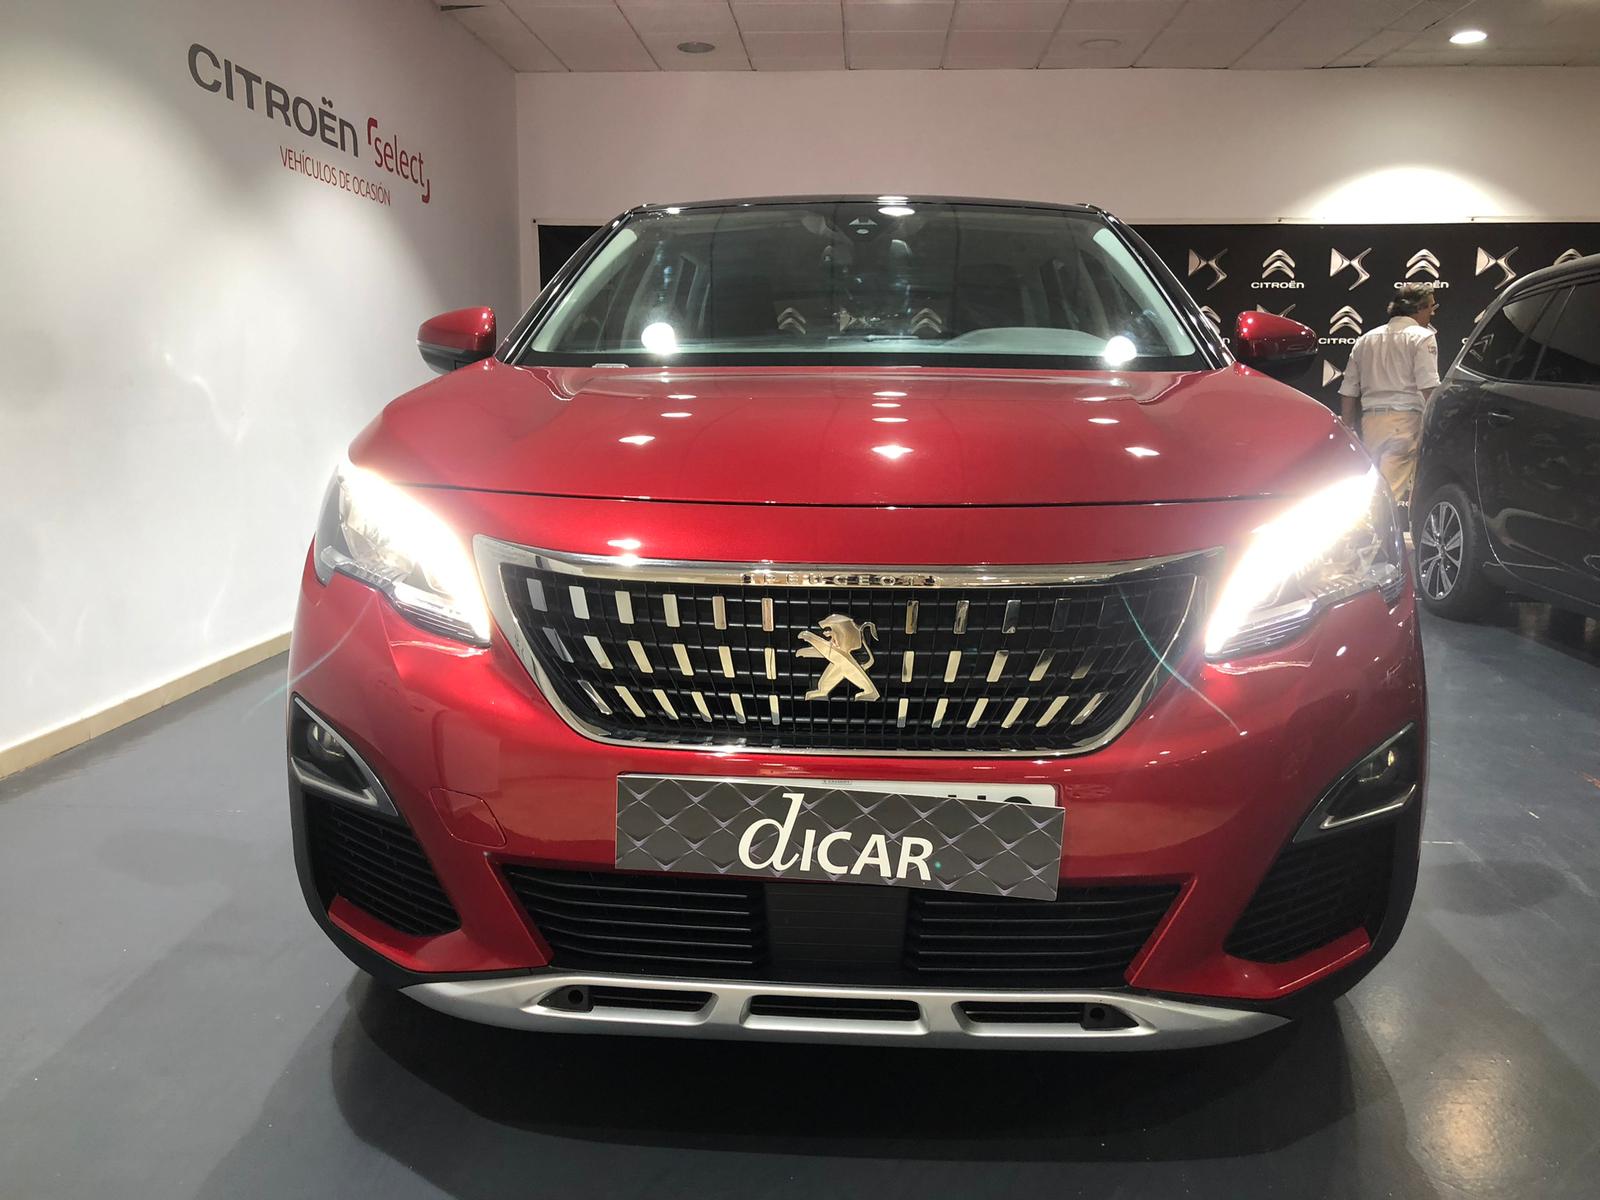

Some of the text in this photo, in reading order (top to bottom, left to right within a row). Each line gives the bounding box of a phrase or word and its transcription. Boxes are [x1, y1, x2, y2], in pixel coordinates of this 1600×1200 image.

[279, 145, 391, 206] VEHÍCULOS DE OCASIÓN
[374, 134, 425, 188] select
